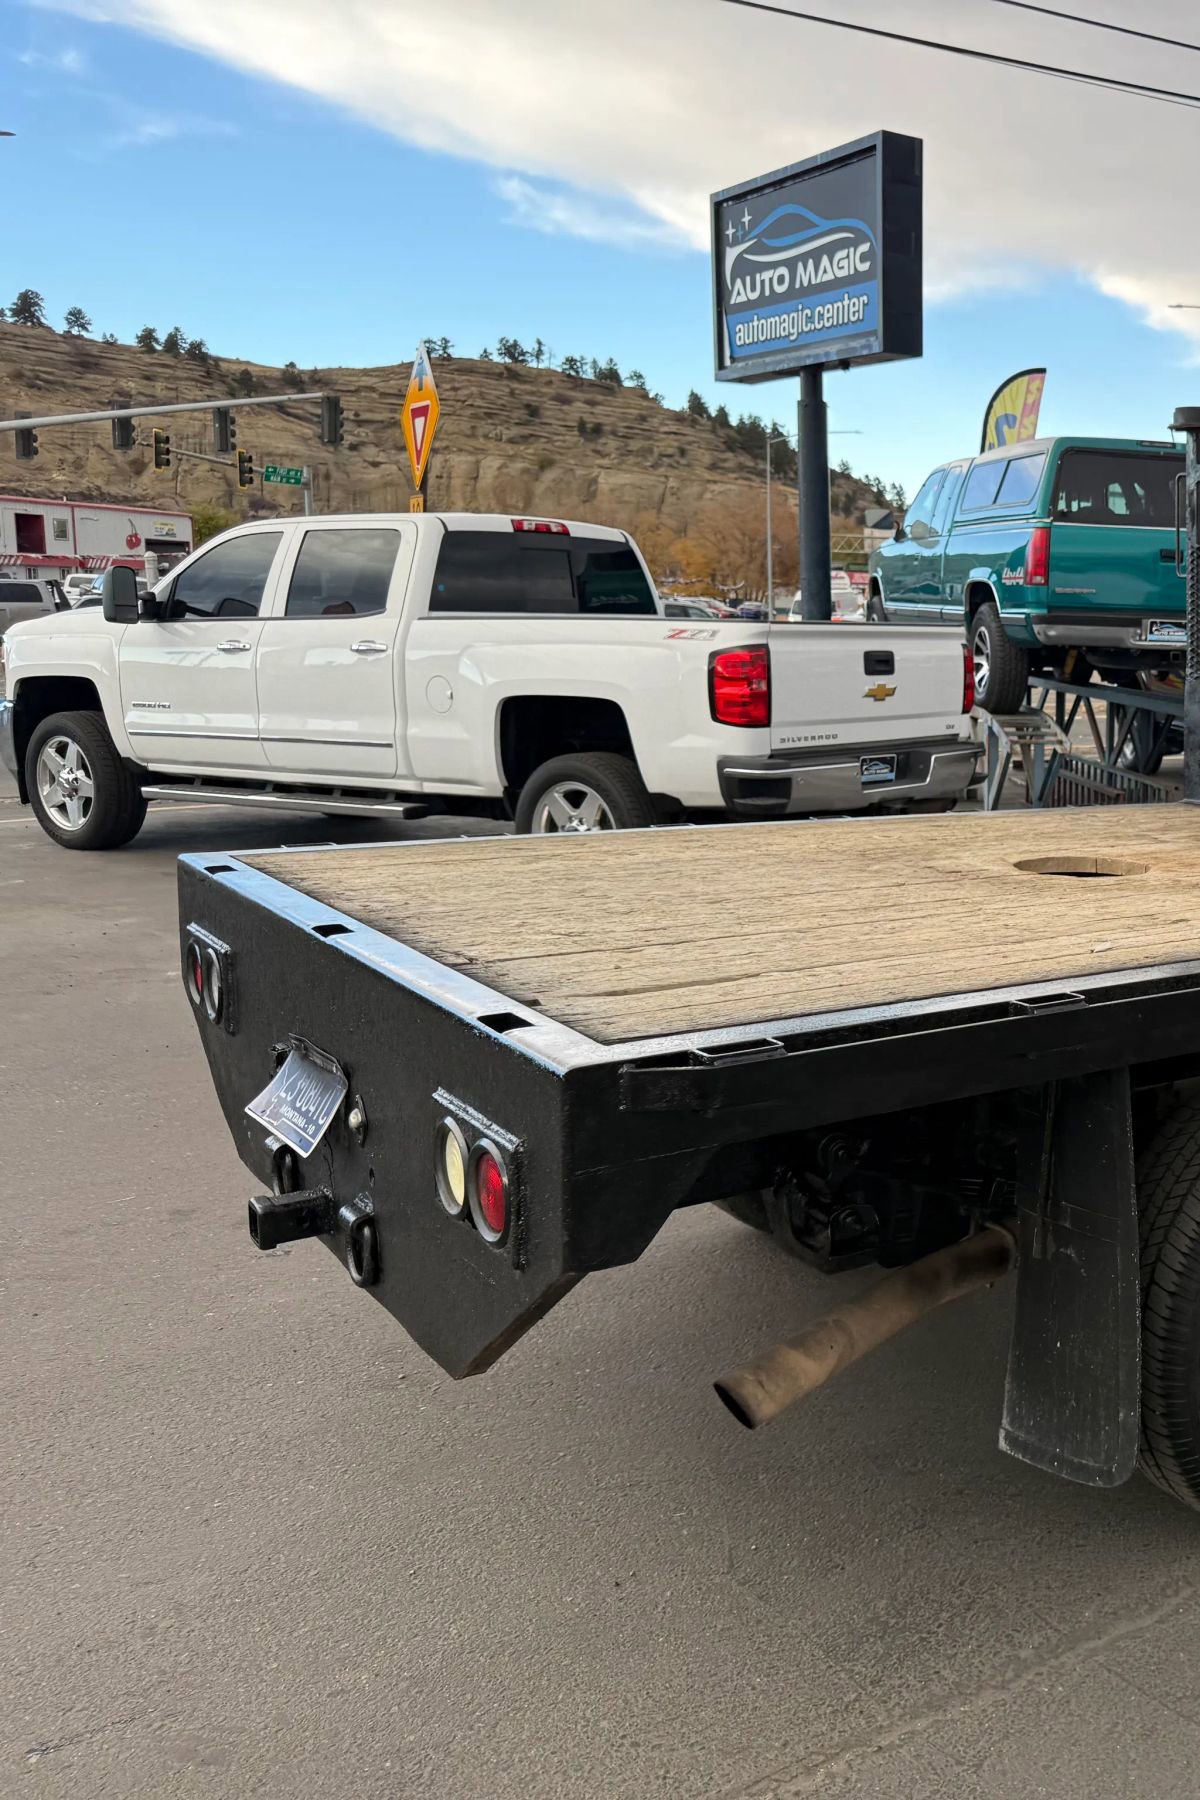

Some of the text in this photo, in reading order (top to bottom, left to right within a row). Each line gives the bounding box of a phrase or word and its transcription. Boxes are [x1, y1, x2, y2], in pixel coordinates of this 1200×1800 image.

[730, 242, 872, 305] AUTO MAGIC
[735, 293, 868, 347] automagic.center
[779, 733, 839, 744] SILVERADO
[280, 1103, 307, 1129] MONTANA
